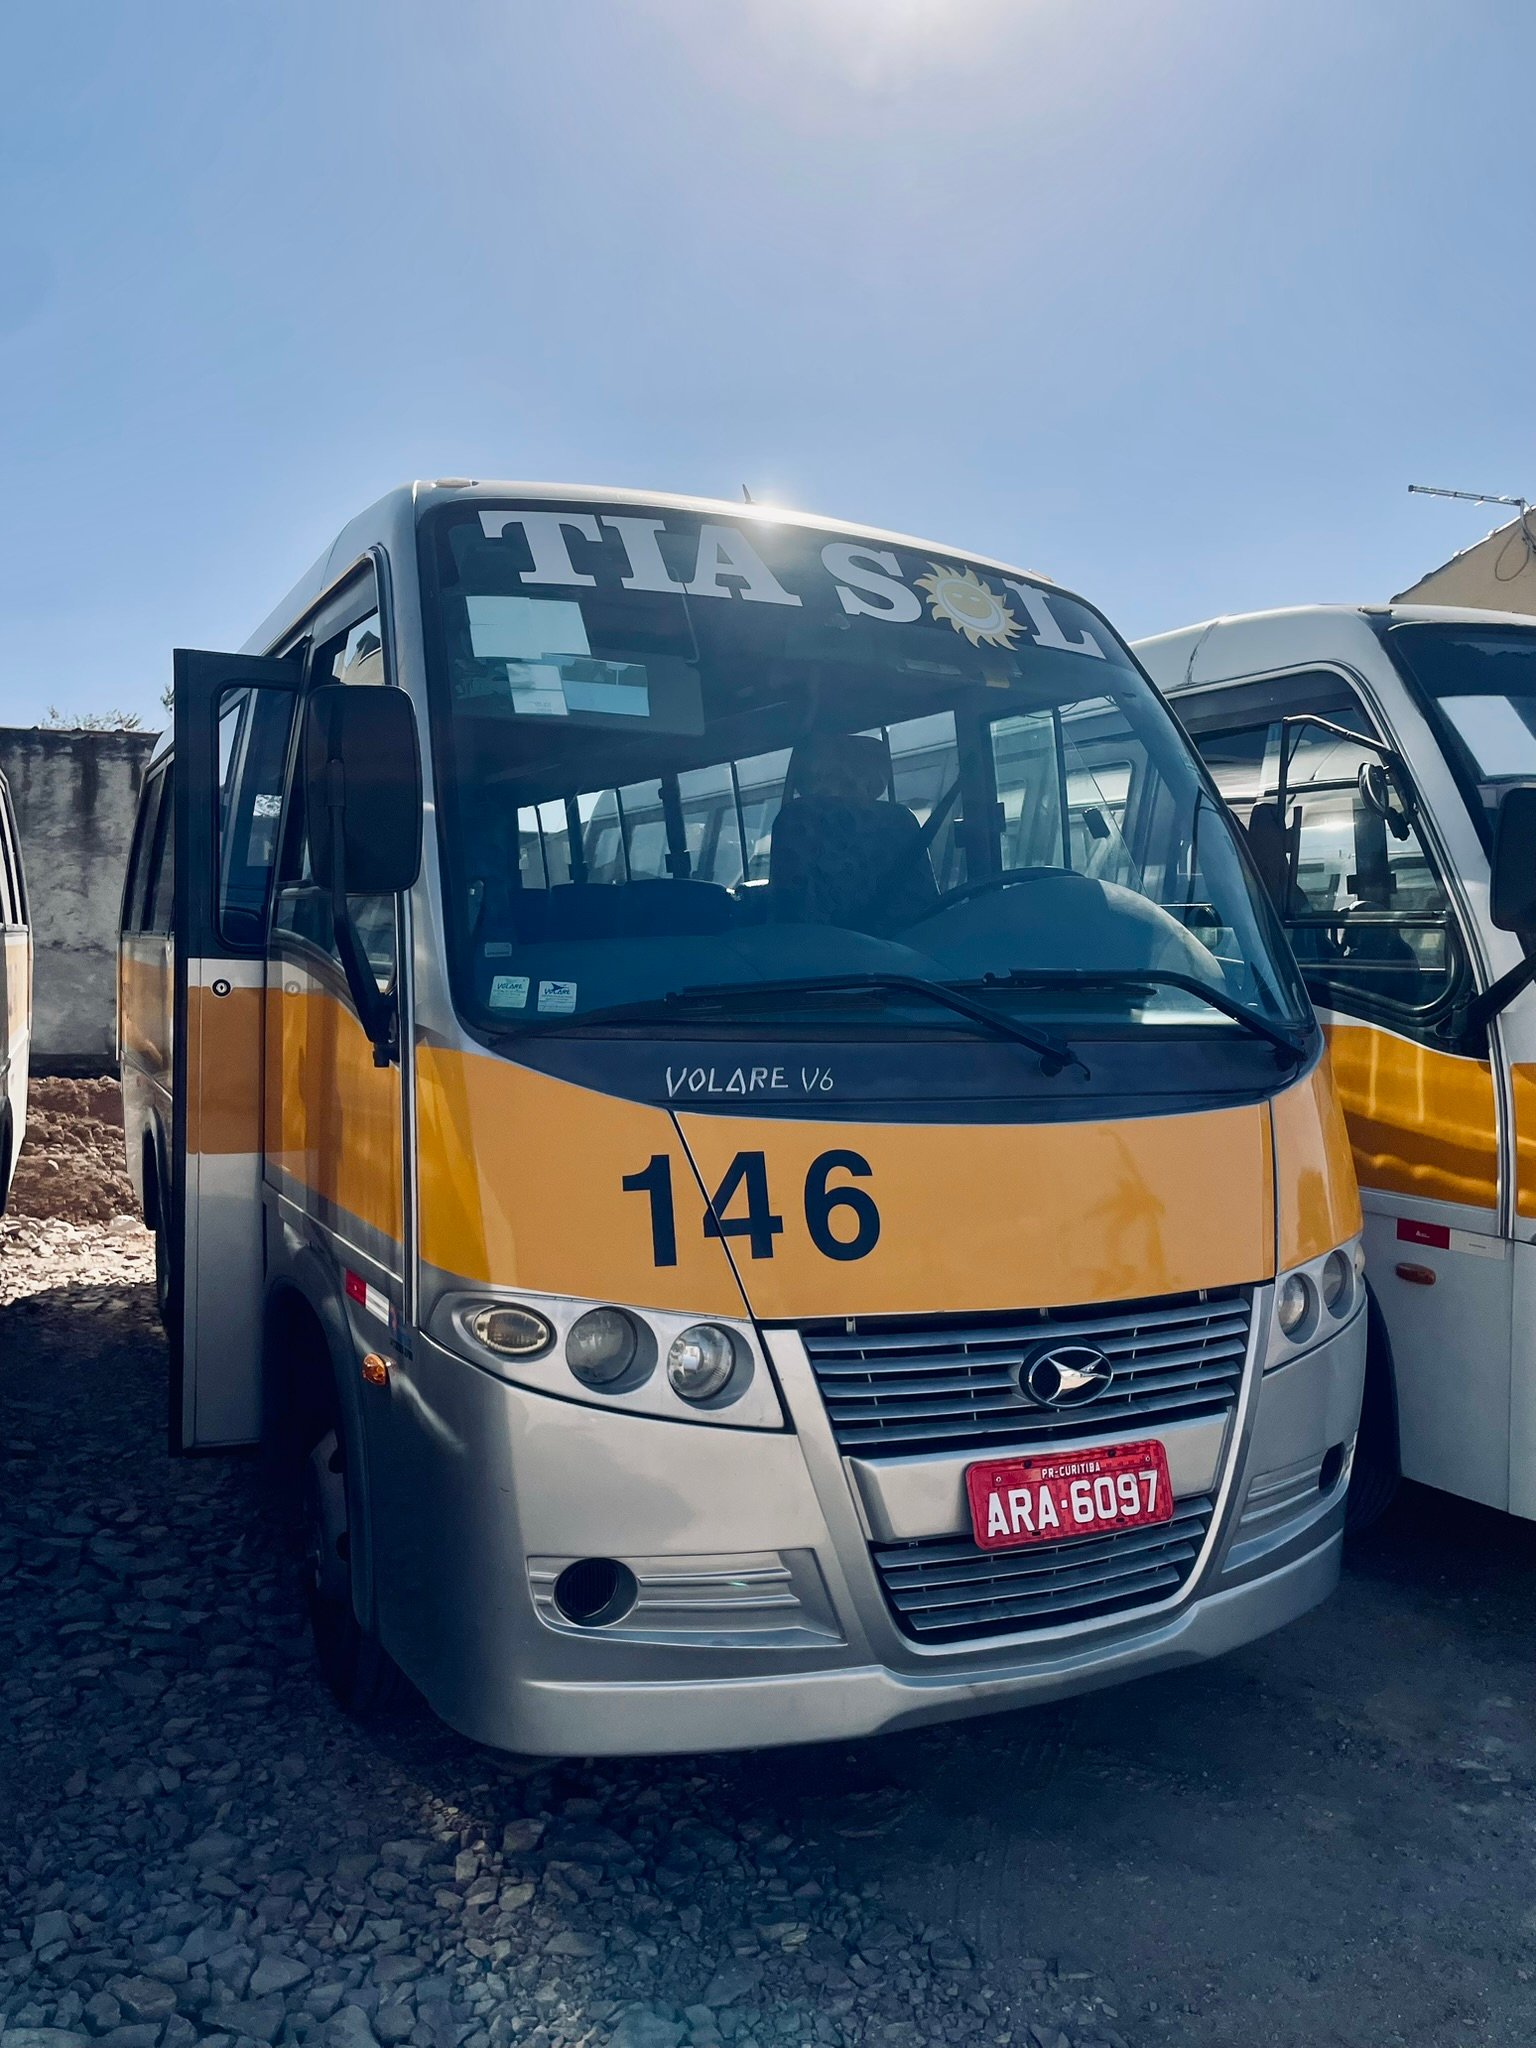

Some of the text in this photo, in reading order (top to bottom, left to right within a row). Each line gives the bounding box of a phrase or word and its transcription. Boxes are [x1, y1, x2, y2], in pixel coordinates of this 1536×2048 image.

[478, 511, 803, 606] TIA
[666, 1067, 834, 1097] VOLARE V6
[622, 1149, 881, 1267] 146
[1041, 1461, 1101, 1479] PR-CURITIBA
